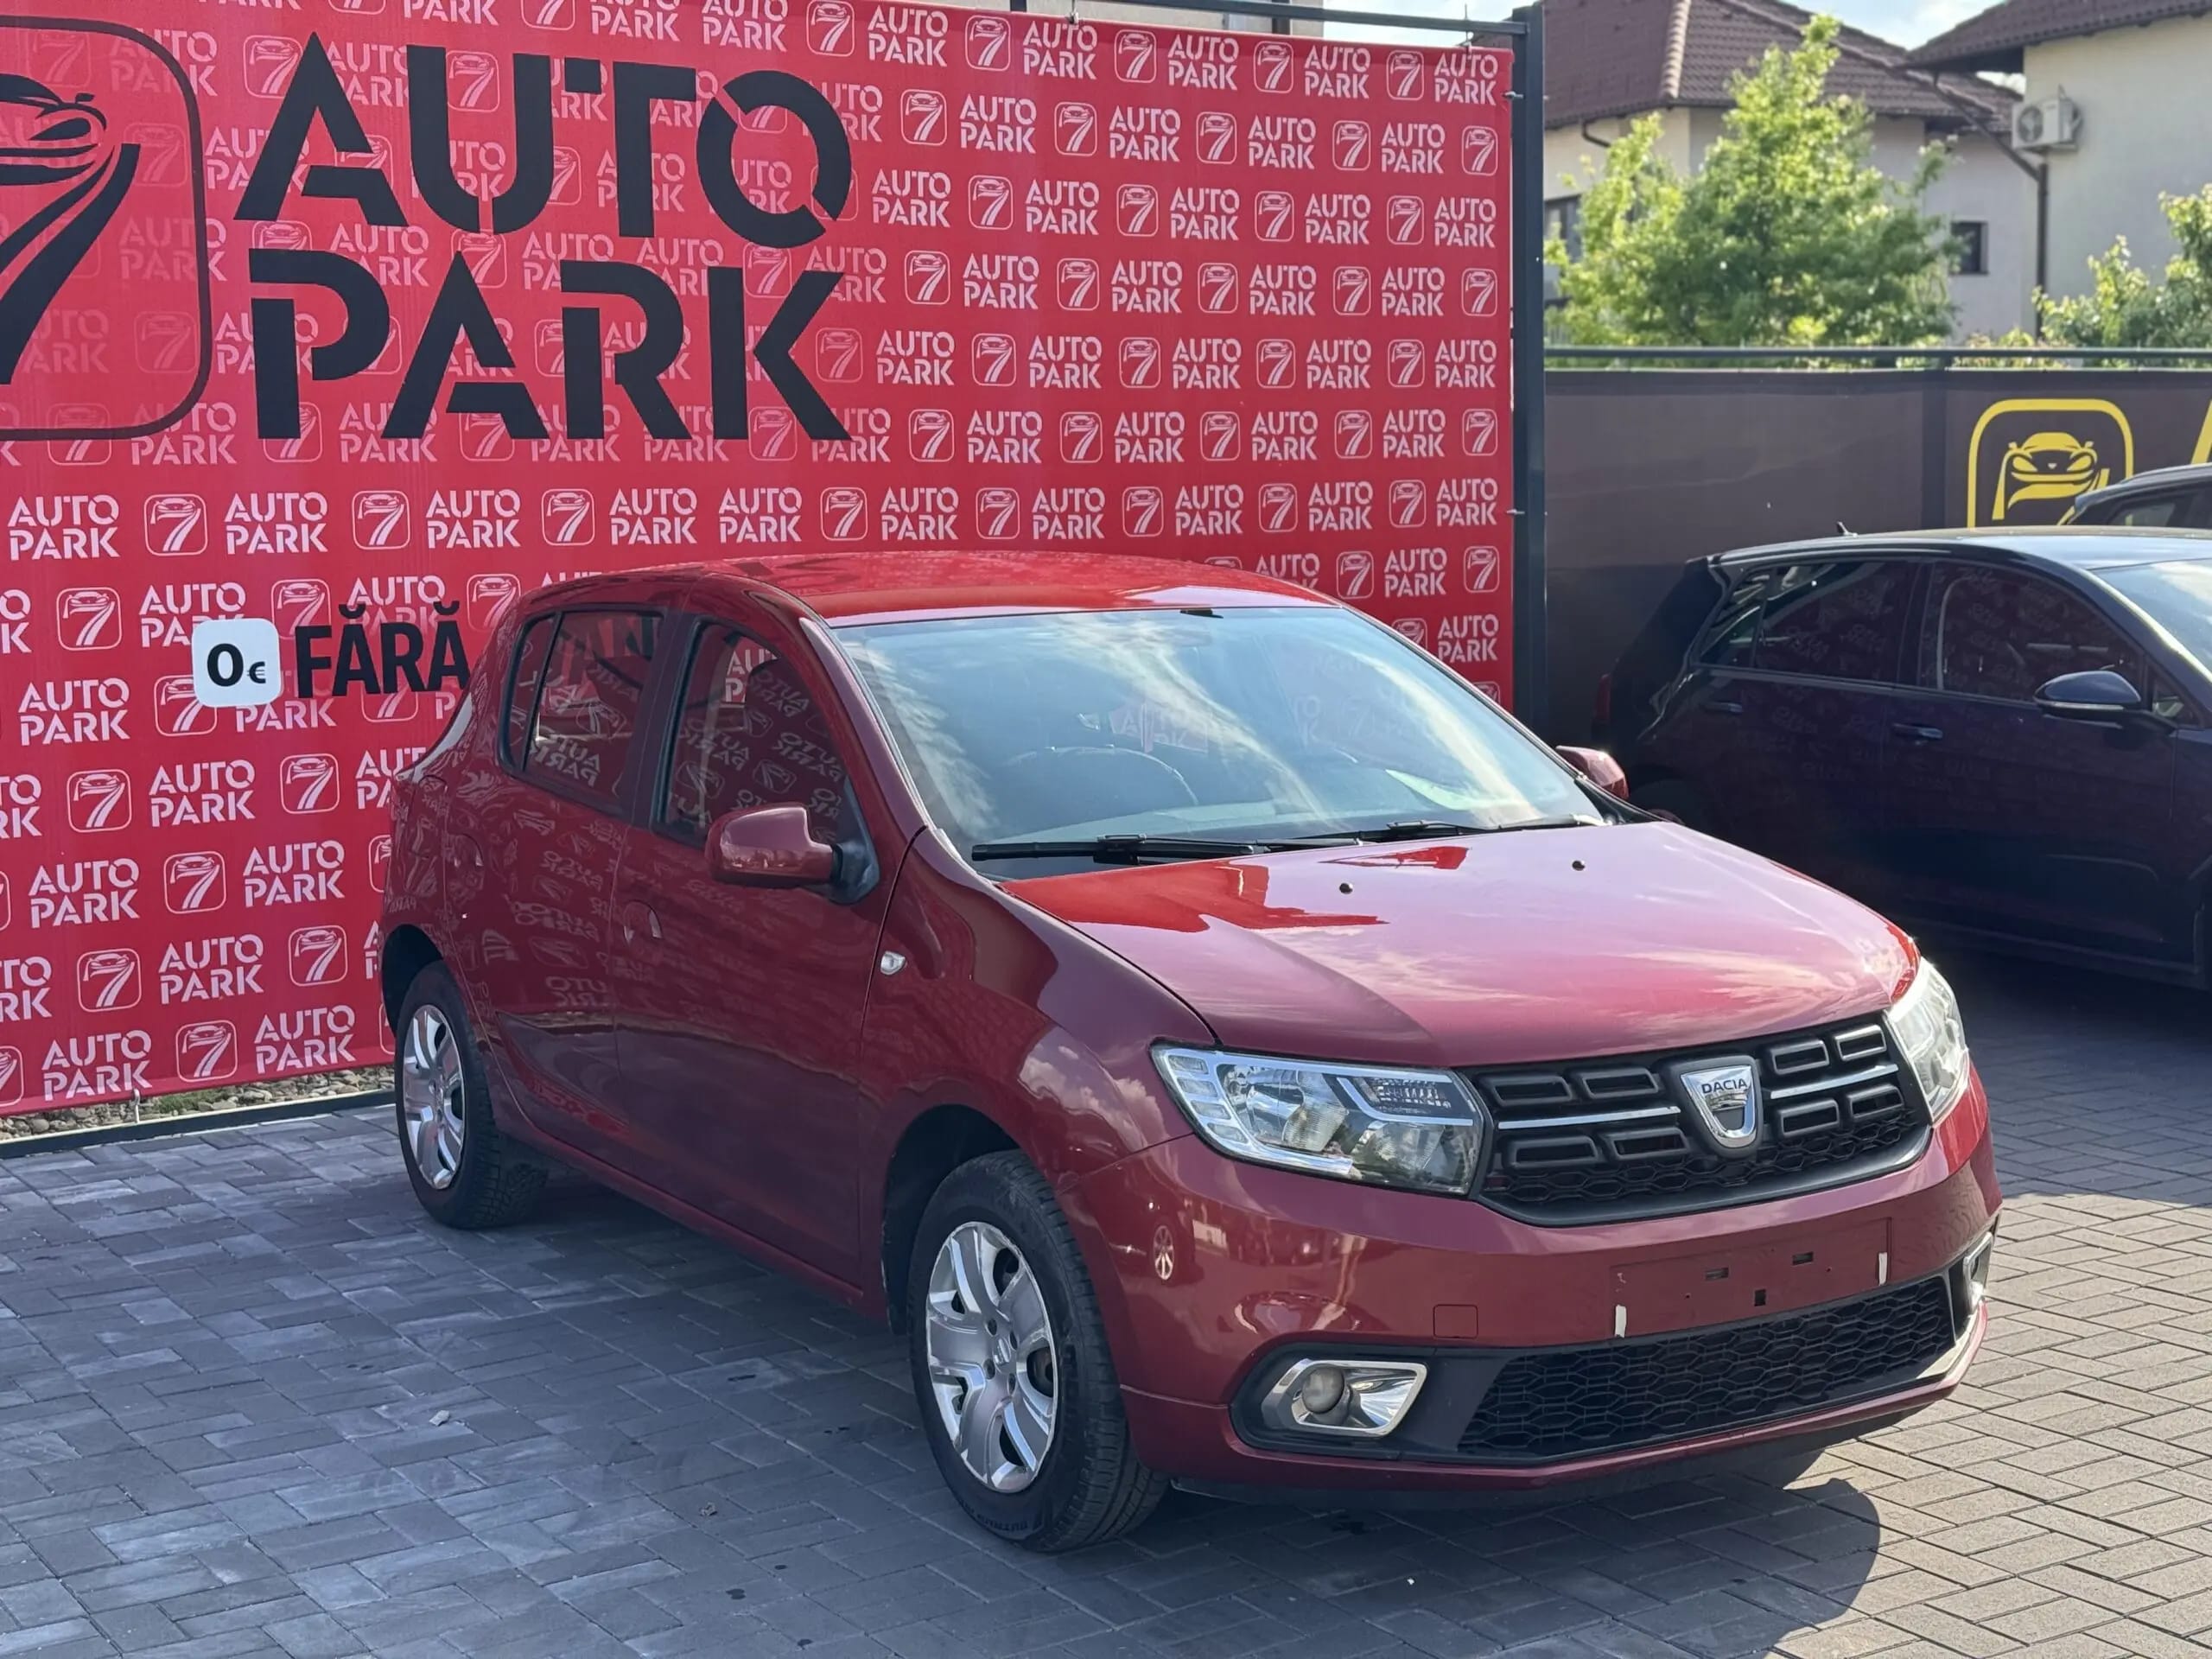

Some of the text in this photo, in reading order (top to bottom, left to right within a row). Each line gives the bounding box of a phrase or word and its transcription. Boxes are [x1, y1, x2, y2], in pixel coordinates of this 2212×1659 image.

[404, 0, 499, 26] PARK
[591, 5, 681, 41] PARK
[868, 5, 948, 37] AUTO
[702, 16, 787, 52] PARK
[1023, 21, 1097, 52] AUTO
[868, 32, 947, 67] PARK
[1167, 35, 1238, 63] AUTO
[1305, 46, 1370, 72] AUTO
[1024, 48, 1096, 79] PARK
[1169, 60, 1237, 90] PARK
[1434, 54, 1497, 79] AUTO
[822, 82, 883, 112] UTO
[1305, 71, 1369, 99] PARK
[1435, 78, 1496, 105] PARK
[959, 93, 1037, 126] AUTO
[1109, 105, 1180, 135] AUTO
[234, 32, 852, 249] AUTO
[961, 122, 1036, 154] PARK
[1248, 115, 1316, 143] AUTO
[1381, 123, 1446, 149] AUTO
[1109, 132, 1179, 162] PARK
[1249, 141, 1314, 169] PARK
[1382, 148, 1444, 175] PARK
[872, 168, 950, 199] AUTO
[1025, 179, 1099, 208] AUTO
[873, 196, 950, 228] PARK
[1169, 187, 1240, 214] AUTO
[1305, 194, 1370, 219] AUTO
[1434, 196, 1496, 223] AUTO
[1026, 206, 1099, 235] PARK
[1171, 213, 1239, 241] PARK
[1306, 219, 1370, 245] PARK
[1434, 221, 1495, 248] PARK
[330, 222, 429, 254] AUTO
[522, 232, 614, 262] AUTO
[637, 238, 724, 267] AUTO
[805, 245, 887, 275] AUTO
[963, 253, 1039, 283] AUTO
[1111, 259, 1182, 287] AUTO
[1249, 264, 1317, 289] AUTO
[1382, 267, 1445, 291] AUTO
[964, 280, 1039, 310] PARK
[1112, 286, 1182, 314] PARK
[1249, 289, 1316, 316] PARK
[1382, 292, 1444, 316] PARK
[249, 248, 853, 440] PARK
[876, 330, 955, 358] AUTO
[1028, 335, 1102, 362] AUTO
[1172, 338, 1242, 363] AUTO
[1306, 337, 1371, 364] AUTO
[1434, 340, 1497, 363] AUTO
[877, 358, 954, 385] PARK
[1029, 362, 1102, 389] PARK
[1173, 364, 1241, 390] PARK
[1307, 365, 1370, 389] PARK
[1435, 364, 1496, 388] PARK
[834, 408, 892, 434] UTO
[967, 410, 1042, 437] AUTO
[1114, 411, 1185, 437] AUTO
[1251, 410, 1318, 435] AUTO
[1382, 409, 1446, 433] AUTO
[131, 434, 238, 466] PARK
[340, 433, 438, 463] PARK
[531, 434, 621, 462] PARK
[644, 434, 729, 462] PARK
[811, 435, 891, 463] PARK
[968, 437, 1041, 464] PARK
[1115, 437, 1185, 463] PARK
[1252, 435, 1317, 461] PARK
[1383, 433, 1445, 458] PARK
[425, 489, 520, 518] AUTO
[609, 487, 697, 516] AUTO
[719, 487, 802, 515] AUTO
[880, 486, 958, 513] AUTO
[1032, 487, 1105, 512] AUTO
[1175, 484, 1243, 510] AUTO
[1308, 481, 1373, 506] AUTO
[1436, 478, 1497, 502] AUTO
[7, 494, 119, 528] AUTO
[224, 492, 327, 523] AUTO
[1309, 505, 1372, 531] PARK
[1437, 502, 1497, 526] PARK
[427, 519, 521, 549] PARK
[611, 517, 697, 545] PARK
[719, 515, 802, 543] PARK
[881, 514, 958, 540] PARK
[1033, 514, 1104, 539] PARK
[1176, 510, 1243, 536] PARK
[9, 526, 120, 562] PARK
[226, 523, 327, 555] PARK
[1384, 548, 1446, 570] AUTO
[139, 582, 247, 614] AUTO
[347, 575, 446, 607] AUTO
[1384, 574, 1446, 598] PARK
[1438, 614, 1499, 639] AUTO
[295, 601, 471, 699] FĂRĂ
[1438, 638, 1497, 663] PARK
[18, 677, 130, 713] AUTO
[20, 709, 130, 746] PARK
[235, 697, 337, 733] PARK
[149, 760, 255, 796] AUTO
[150, 790, 256, 827] PARK
[243, 840, 345, 877] AUTO
[28, 858, 139, 896] AUTO
[245, 869, 345, 908] PARK
[30, 888, 140, 929] PARK
[158, 934, 264, 973] AUTO
[0, 956, 52, 989] TO
[160, 964, 264, 1004] PARK
[0, 987, 53, 1023] RK
[254, 1005, 355, 1044] AUTO
[41, 1030, 152, 1070] AUTO
[256, 1034, 356, 1073] PARK
[44, 1060, 153, 1102] PARK
[1701, 1077, 1747, 1094] DACIA
